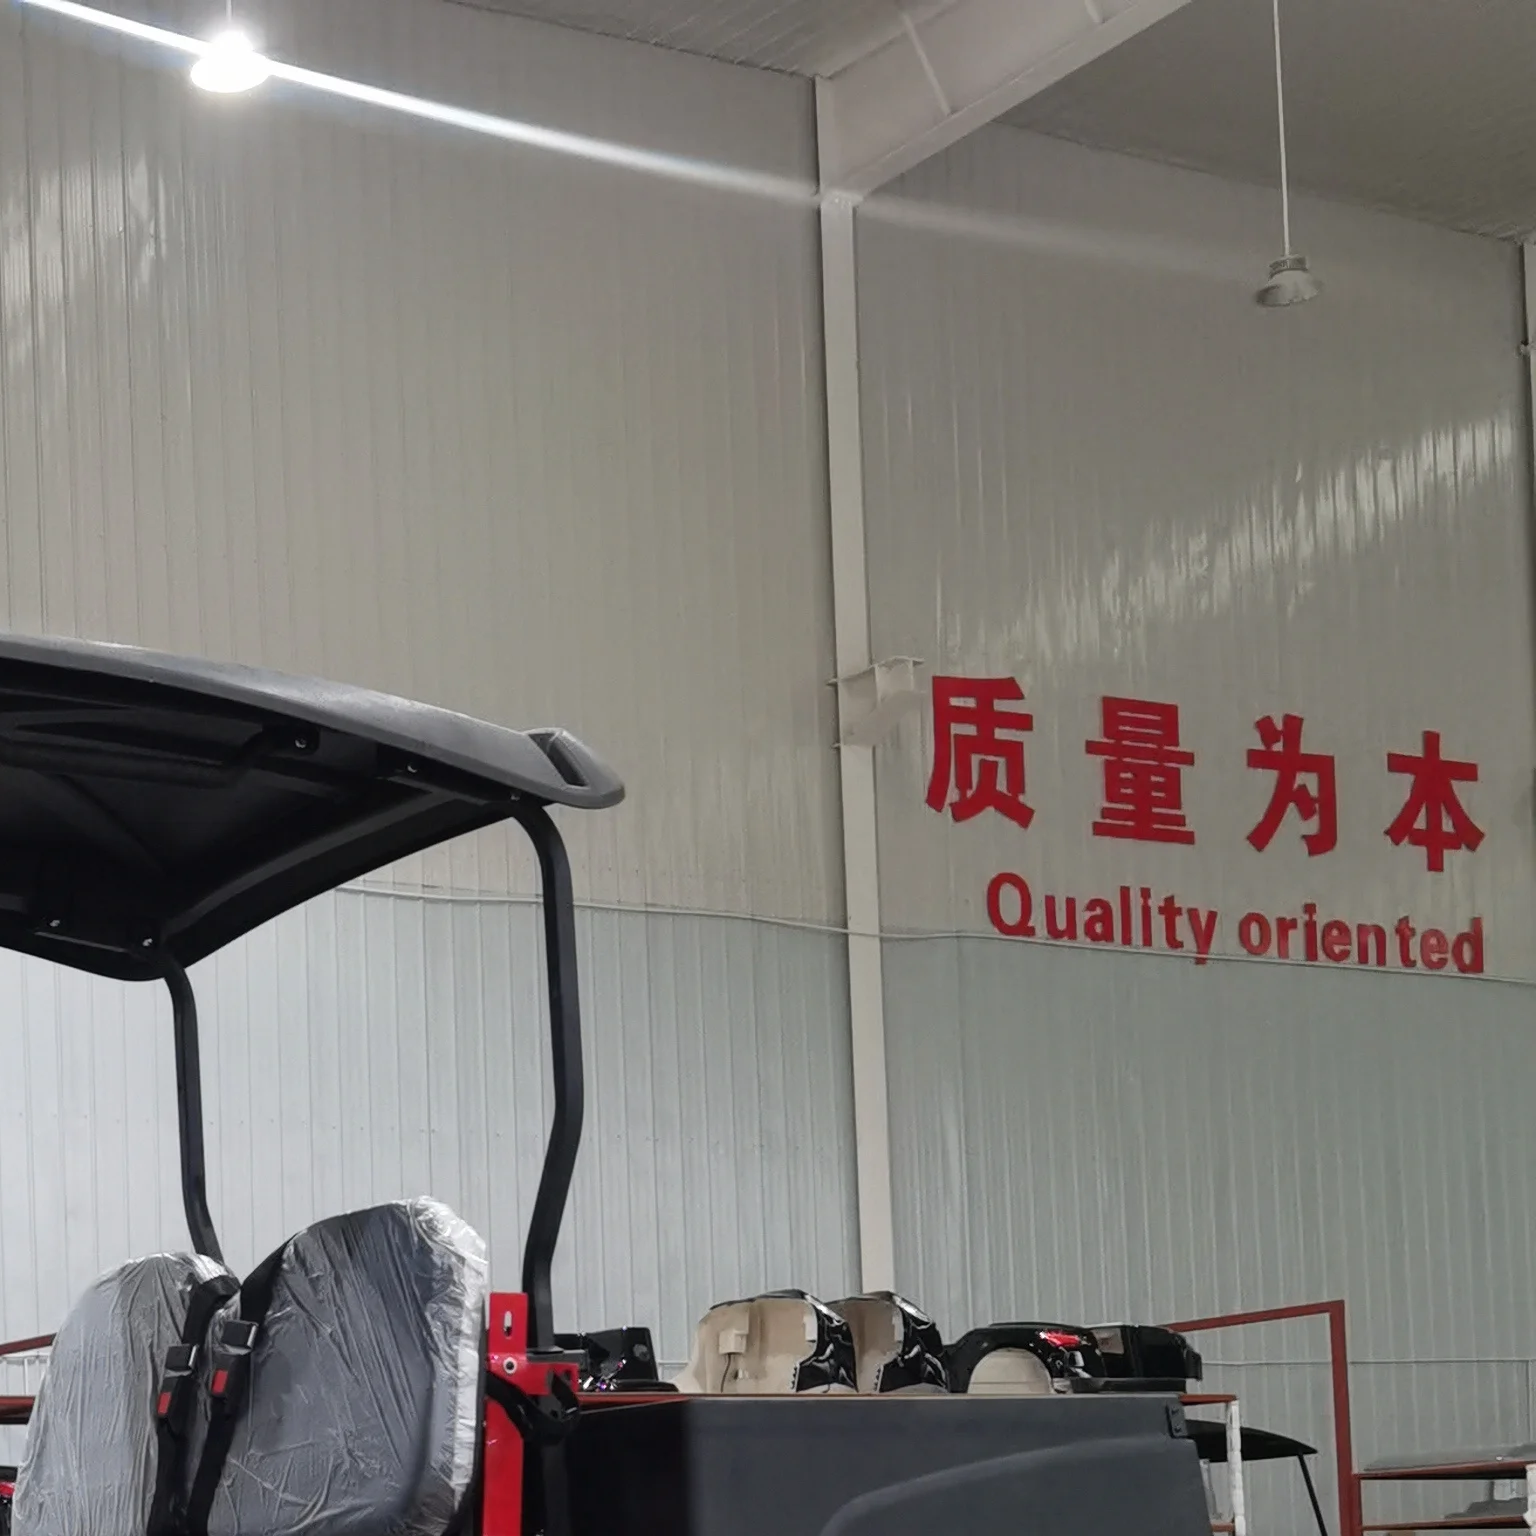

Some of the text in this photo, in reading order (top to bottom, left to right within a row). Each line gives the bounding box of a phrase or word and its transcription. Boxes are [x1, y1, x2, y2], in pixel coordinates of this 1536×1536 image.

[926, 676, 1485, 873] 质量为本
[987, 872, 1484, 974] Quality oriented
